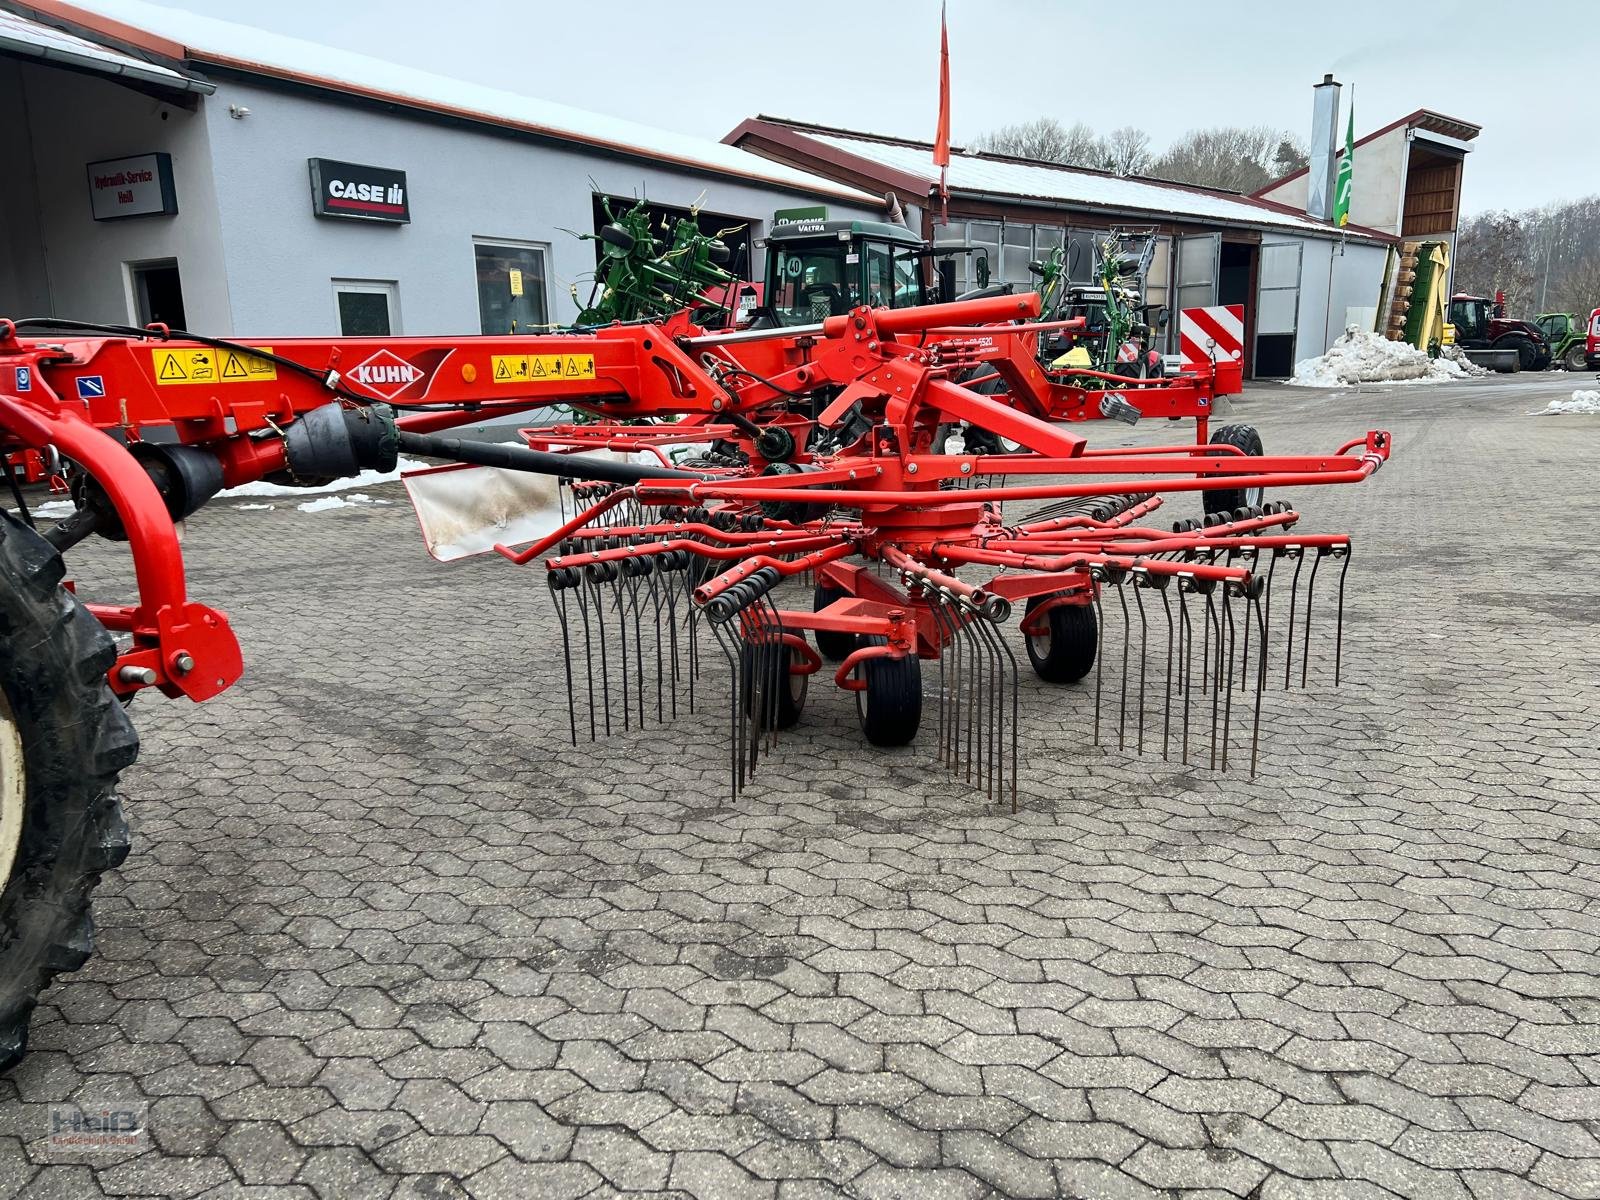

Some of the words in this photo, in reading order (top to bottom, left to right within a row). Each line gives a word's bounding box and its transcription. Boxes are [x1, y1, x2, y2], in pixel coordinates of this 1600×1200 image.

[329, 179, 384, 203] CASE
[798, 224, 825, 232] VALTRA
[789, 260, 800, 273] 40
[358, 365, 414, 384] KUHN
